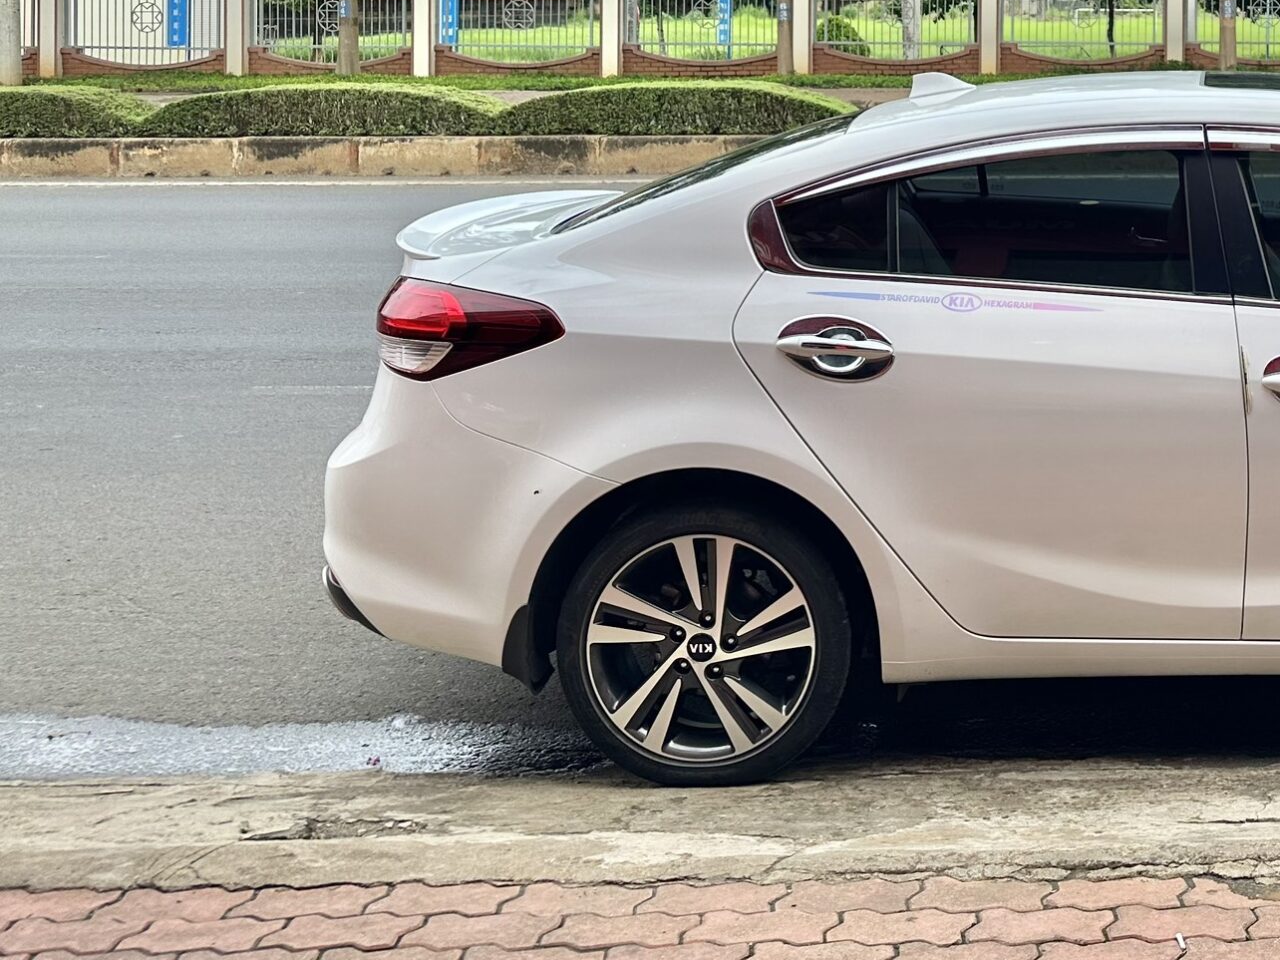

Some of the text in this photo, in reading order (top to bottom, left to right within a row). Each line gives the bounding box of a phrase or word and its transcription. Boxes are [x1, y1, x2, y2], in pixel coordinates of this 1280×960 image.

[880, 293, 1033, 309] STAROFDAVID KIA HEXAGRAM
[689, 643, 713, 654] KIA
